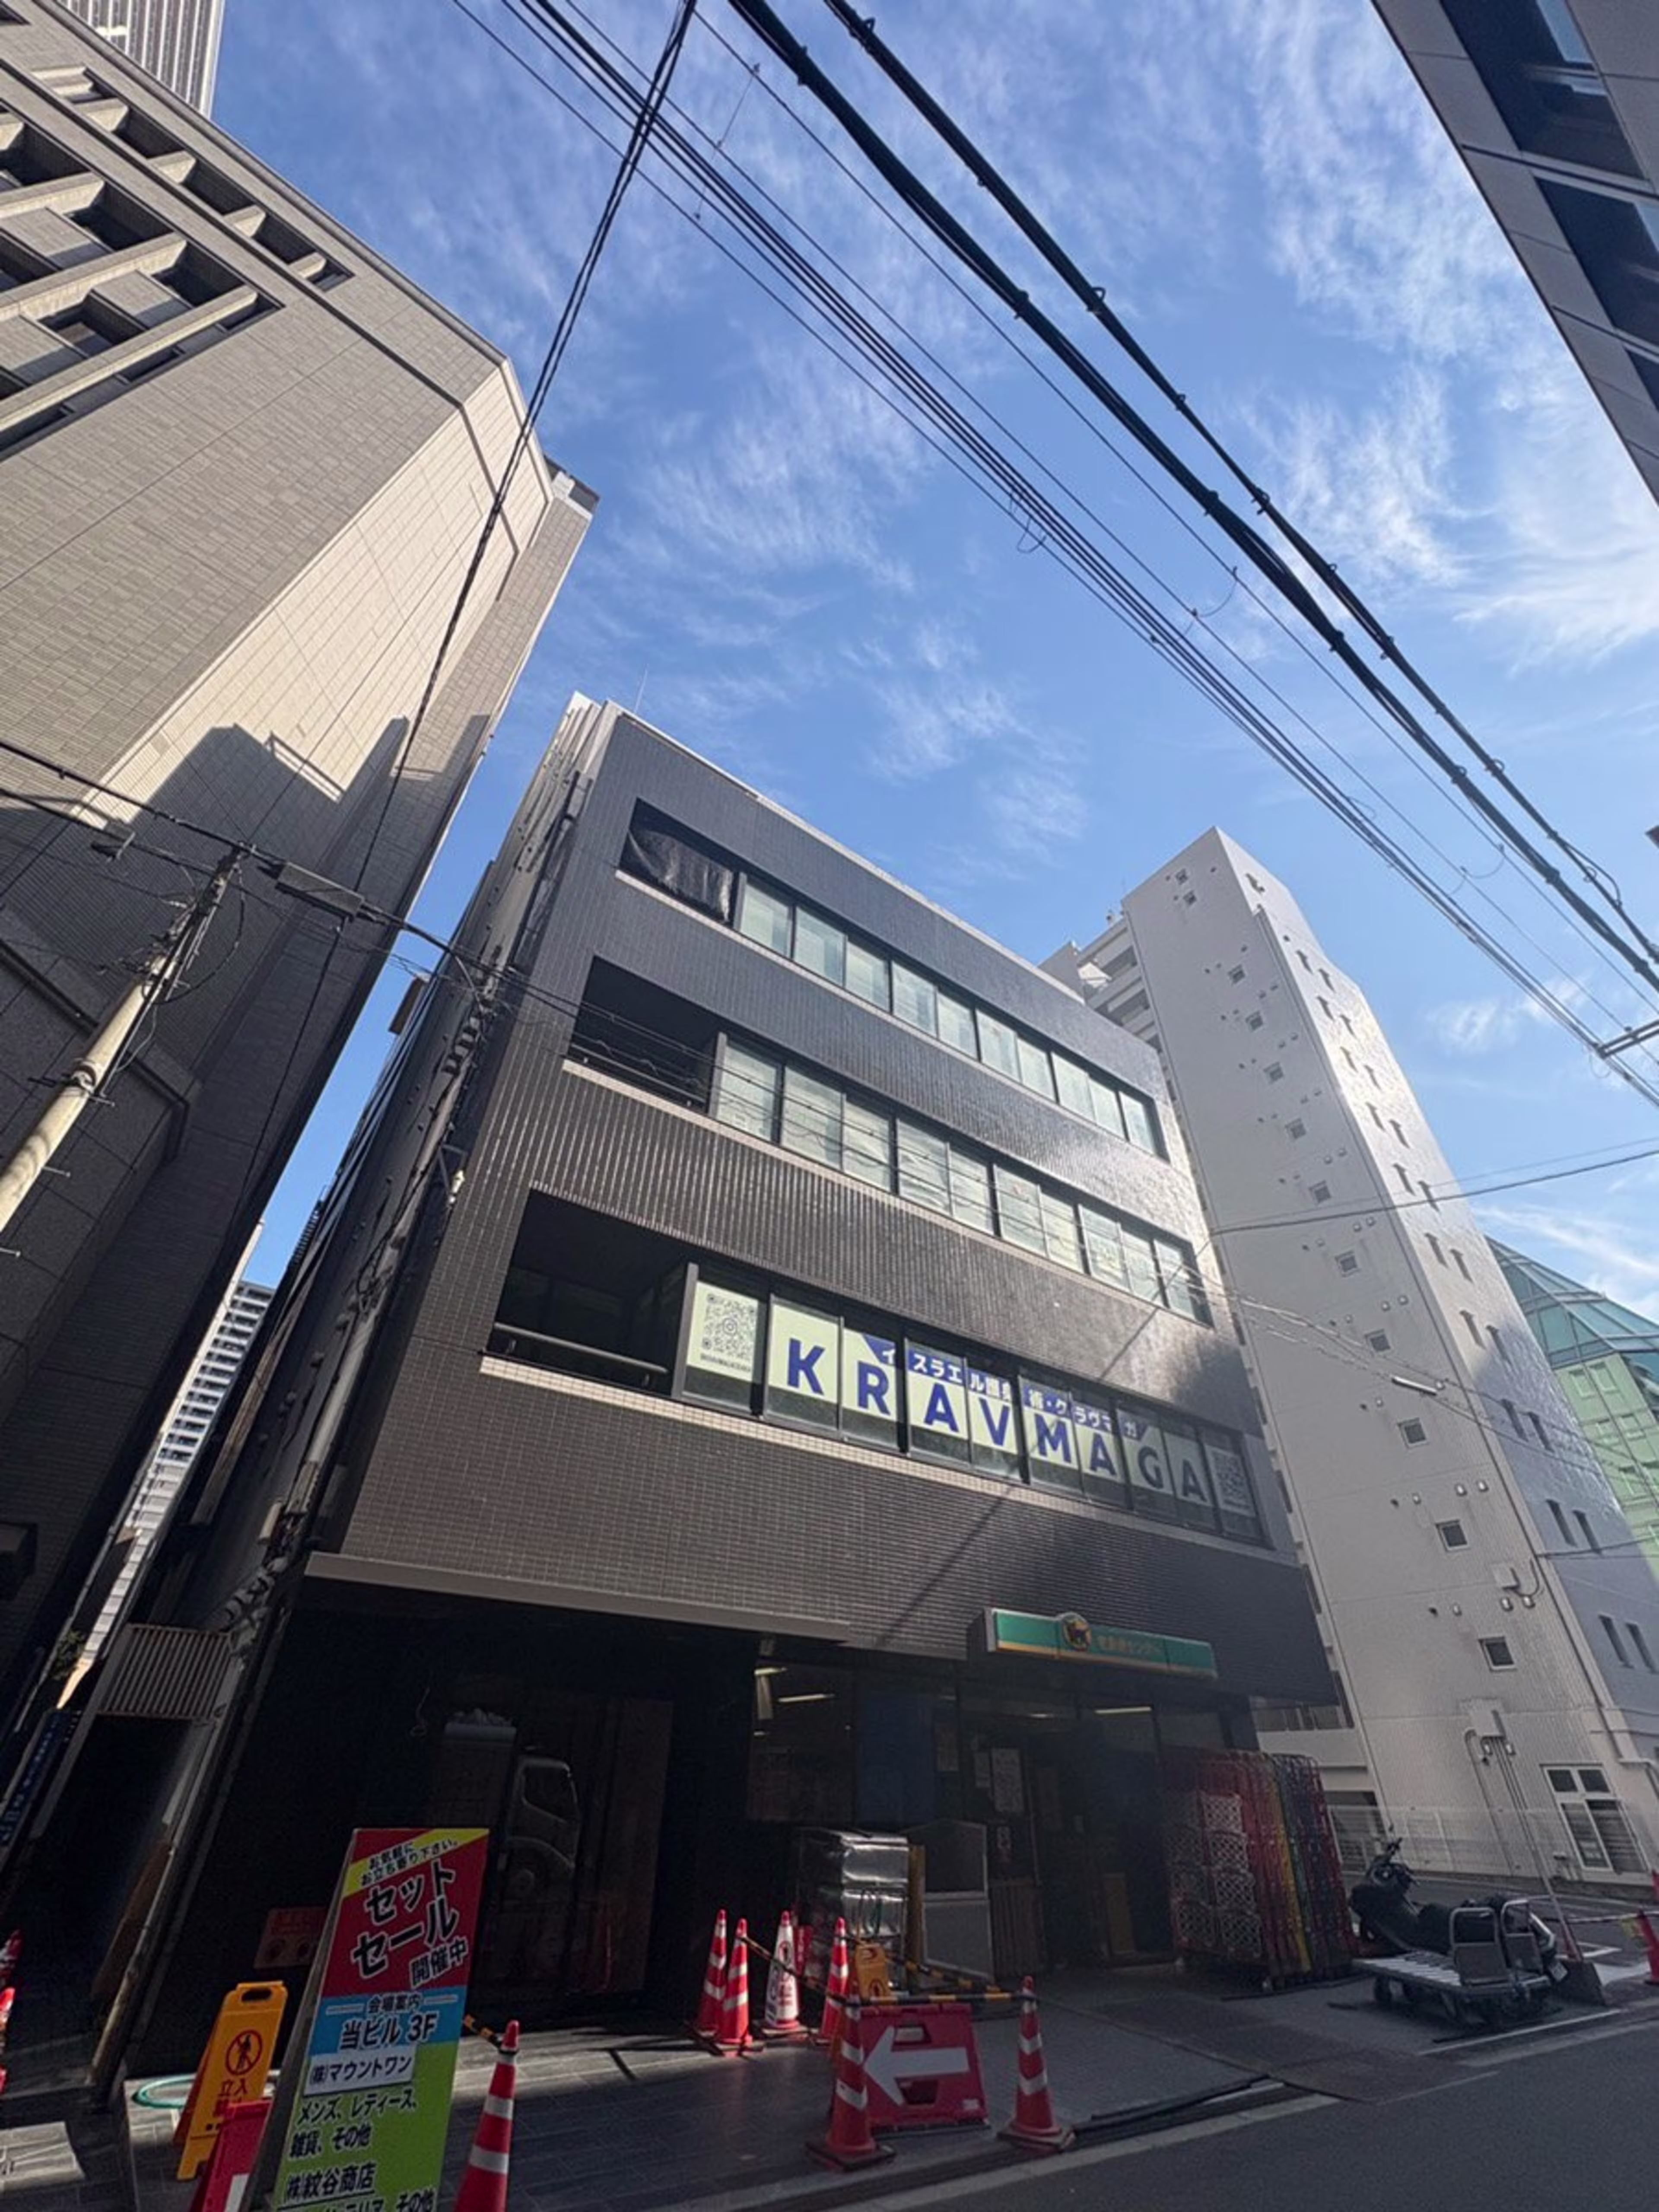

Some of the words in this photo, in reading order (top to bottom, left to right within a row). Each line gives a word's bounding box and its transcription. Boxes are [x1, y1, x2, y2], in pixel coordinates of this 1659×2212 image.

[366, 1861, 453, 1923] セット
[353, 1898, 458, 1976] セール
[412, 1939, 466, 1985] 開催中
[369, 1993, 420, 2013] 会場案内
[341, 2016, 400, 2050] 当ビル
[407, 2013, 437, 2041] 3F
